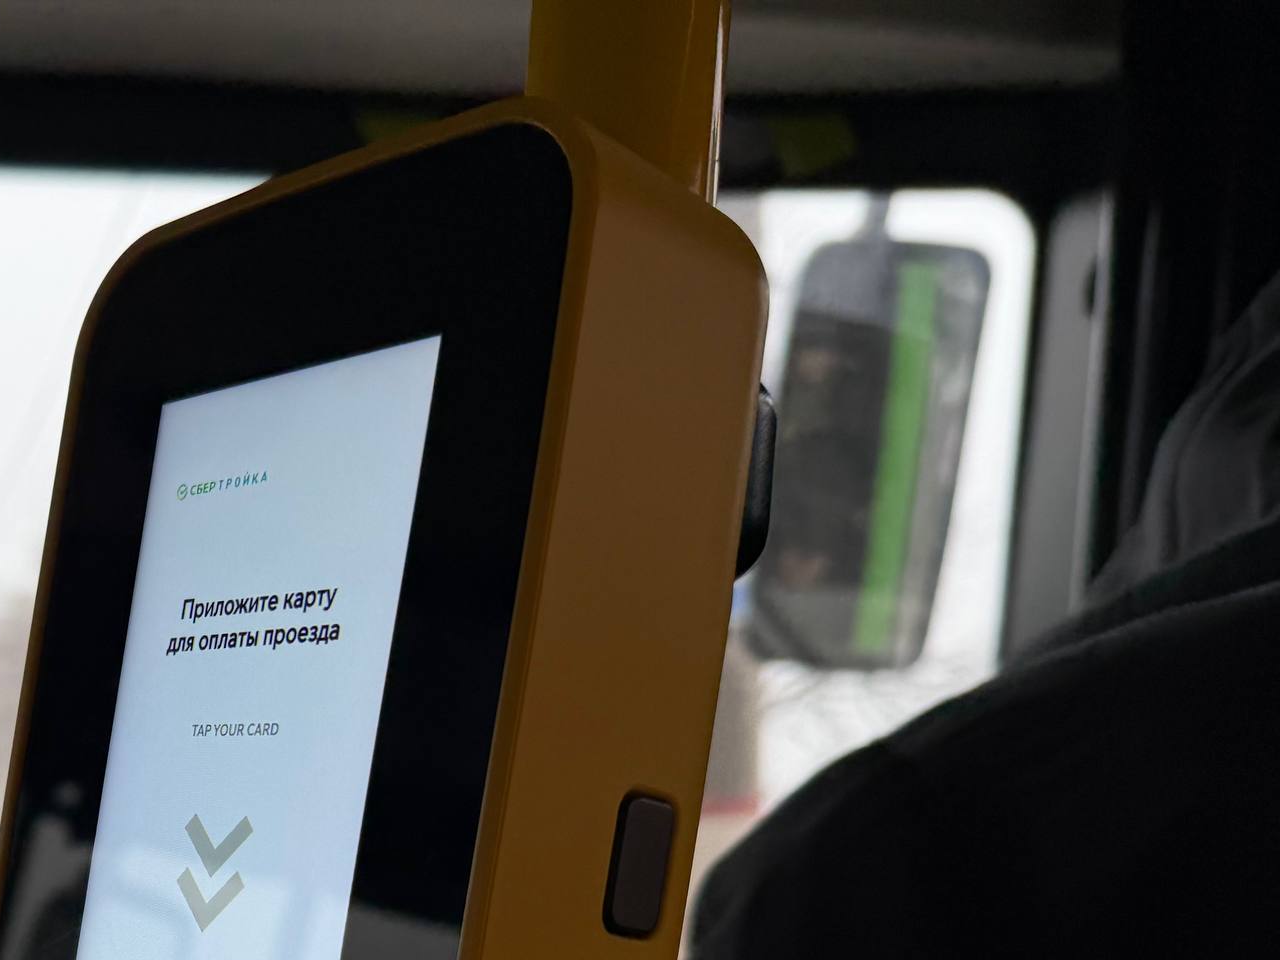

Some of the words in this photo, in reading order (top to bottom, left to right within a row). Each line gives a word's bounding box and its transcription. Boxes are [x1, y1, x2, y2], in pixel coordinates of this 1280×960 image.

[180, 592, 279, 624] Приложите
[282, 587, 338, 613] карту
[166, 636, 195, 656] для
[198, 630, 259, 652] оплаты
[263, 622, 341, 650] проезда
[191, 724, 212, 737] TAP
[214, 723, 245, 737] YOUR
[246, 722, 279, 736] CARD
